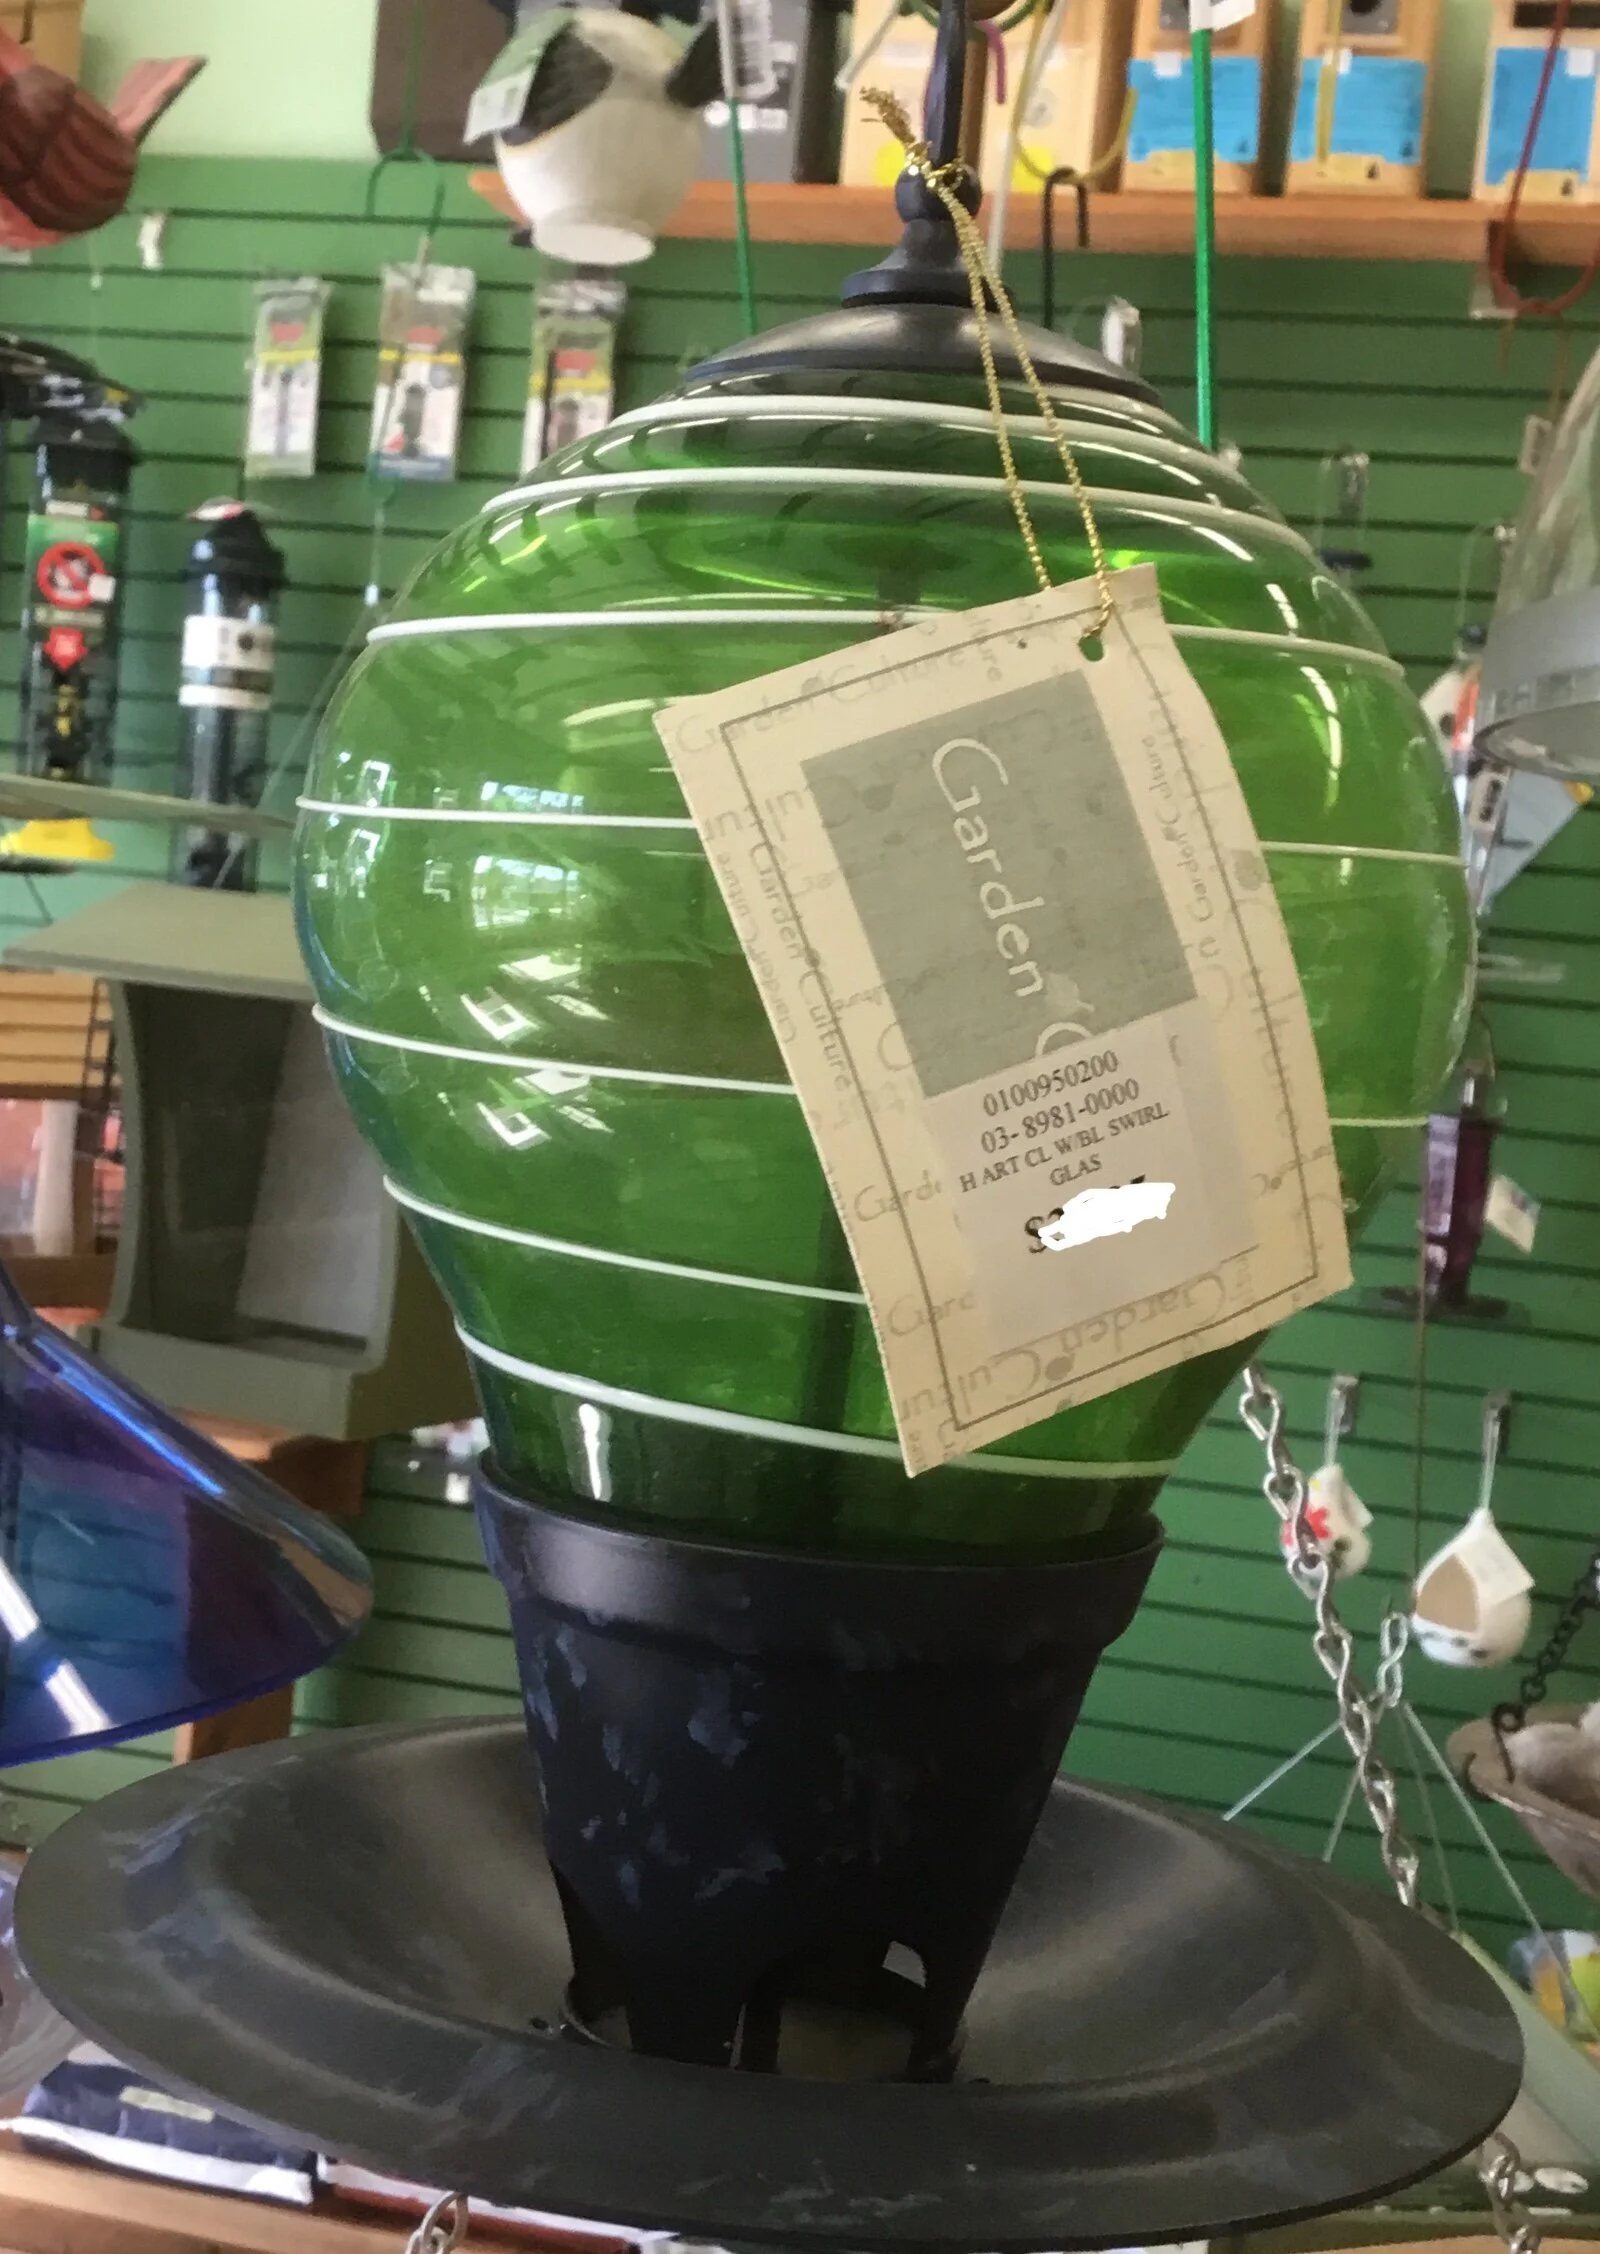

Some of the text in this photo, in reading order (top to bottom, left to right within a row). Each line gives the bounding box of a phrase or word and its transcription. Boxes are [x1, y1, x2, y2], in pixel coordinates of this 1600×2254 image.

[932, 738, 1046, 998] Garden
[983, 1050, 1119, 1116] 0100950200
[959, 1172, 977, 1193] H
[982, 1155, 1020, 1185] ART
[1024, 1146, 1053, 1168] CL
[1107, 1102, 1171, 1137] SWIRL
[1050, 1153, 1103, 1187] GLAS
[901, 1350, 1040, 1422] Cultur
